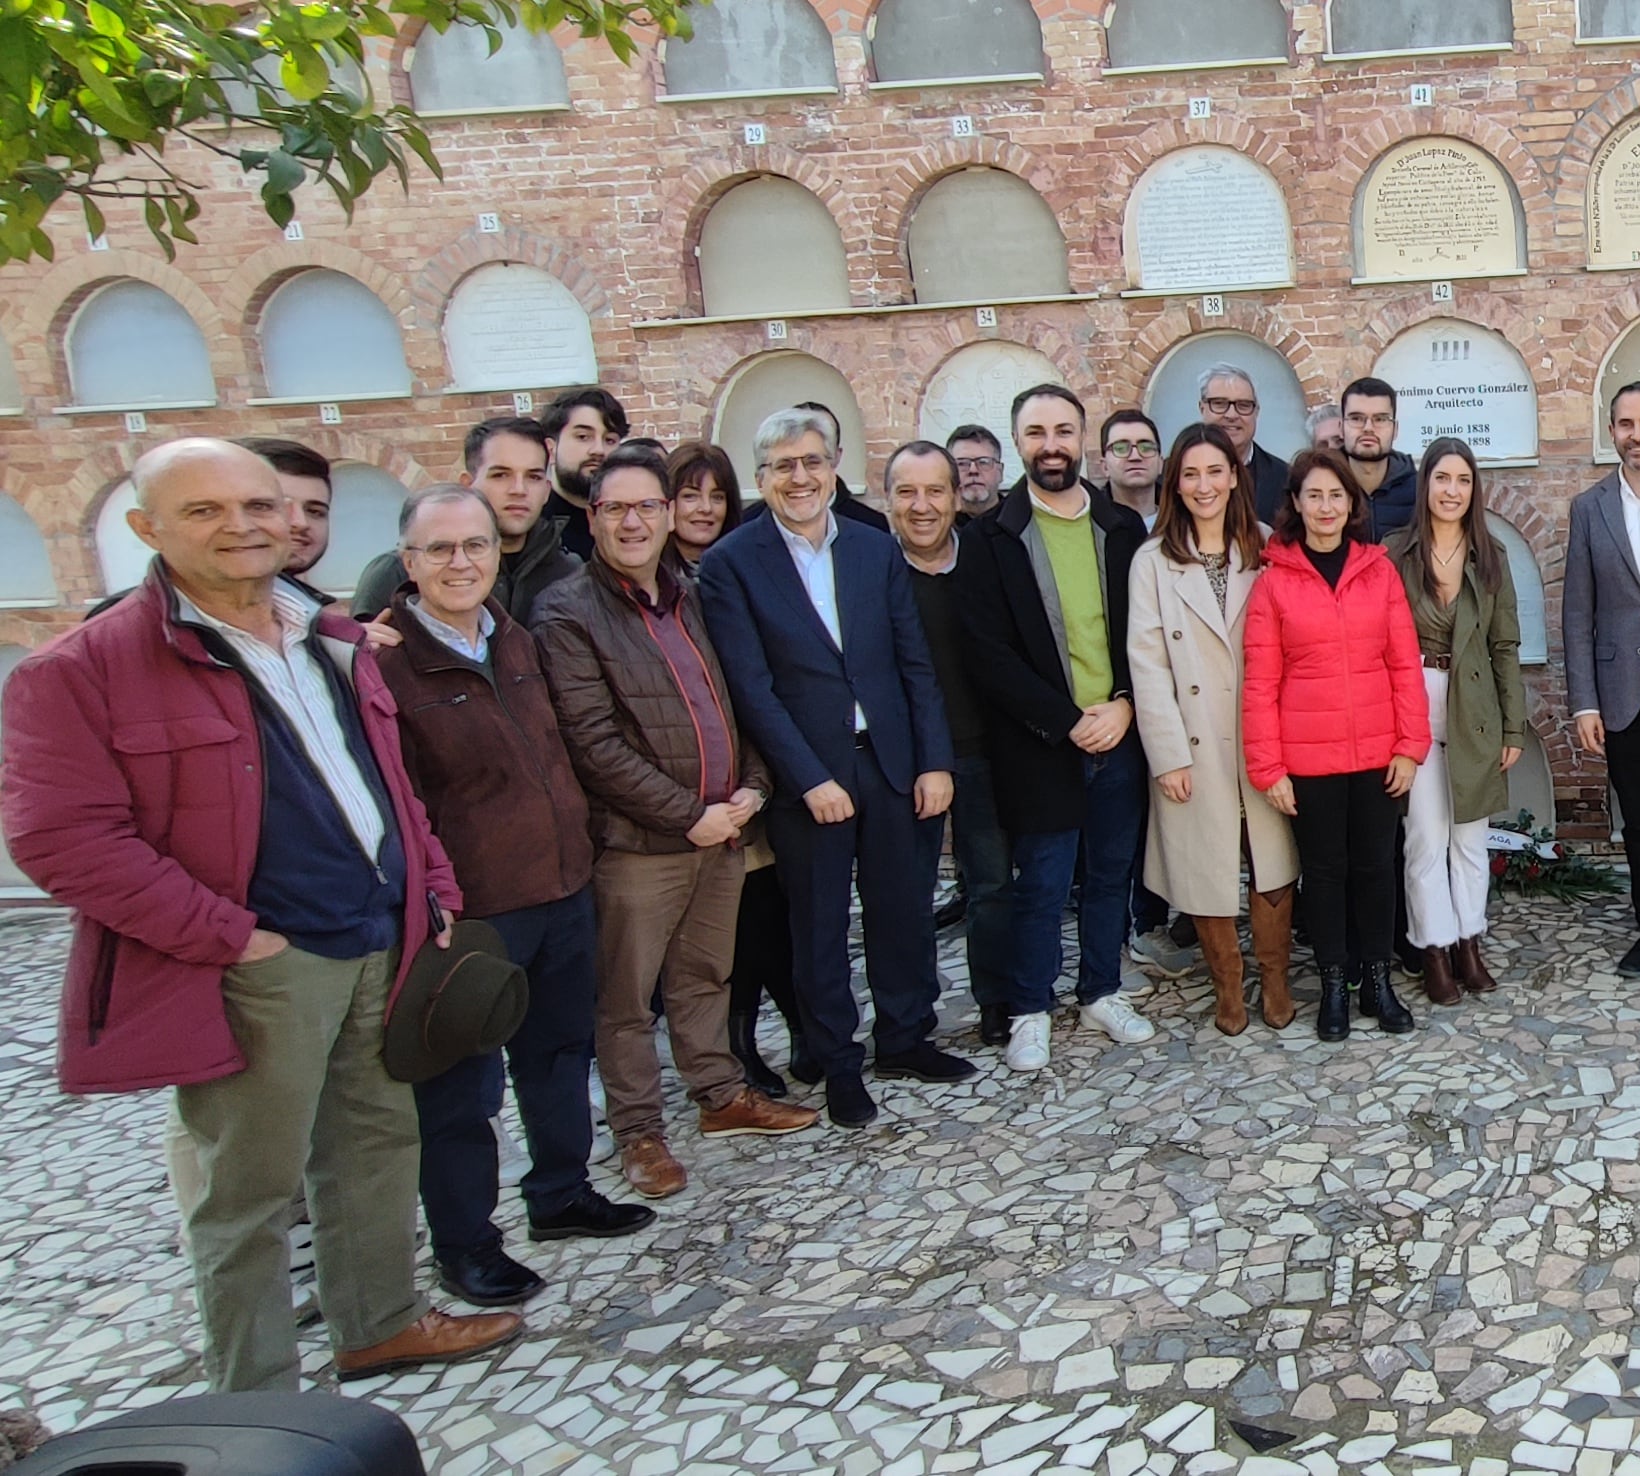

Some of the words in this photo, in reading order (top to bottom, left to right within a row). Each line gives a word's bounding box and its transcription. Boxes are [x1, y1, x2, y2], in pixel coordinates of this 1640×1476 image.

[1415, 88, 1428, 103] 41
[1193, 101, 1207, 116] 37
[748, 127, 761, 142] 29
[956, 120, 969, 135] 33
[483, 215, 495, 230] 25
[1435, 284, 1448, 299] 42
[1207, 297, 1220, 313] 38
[980, 309, 992, 324] 34
[770, 323, 784, 337] 30
[1396, 385, 1433, 398] rónimo
[1436, 384, 1475, 396] Cuervo
[1478, 382, 1529, 395] González
[516, 395, 530, 410] 26
[1424, 398, 1484, 410] Arquitecto
[325, 406, 337, 421] 22
[1421, 425, 1433, 436] 30
[1435, 423, 1463, 437] junio
[1467, 424, 1490, 434] 1838
[1467, 437, 1491, 447] 1898
[1488, 835, 1512, 846] AGA
